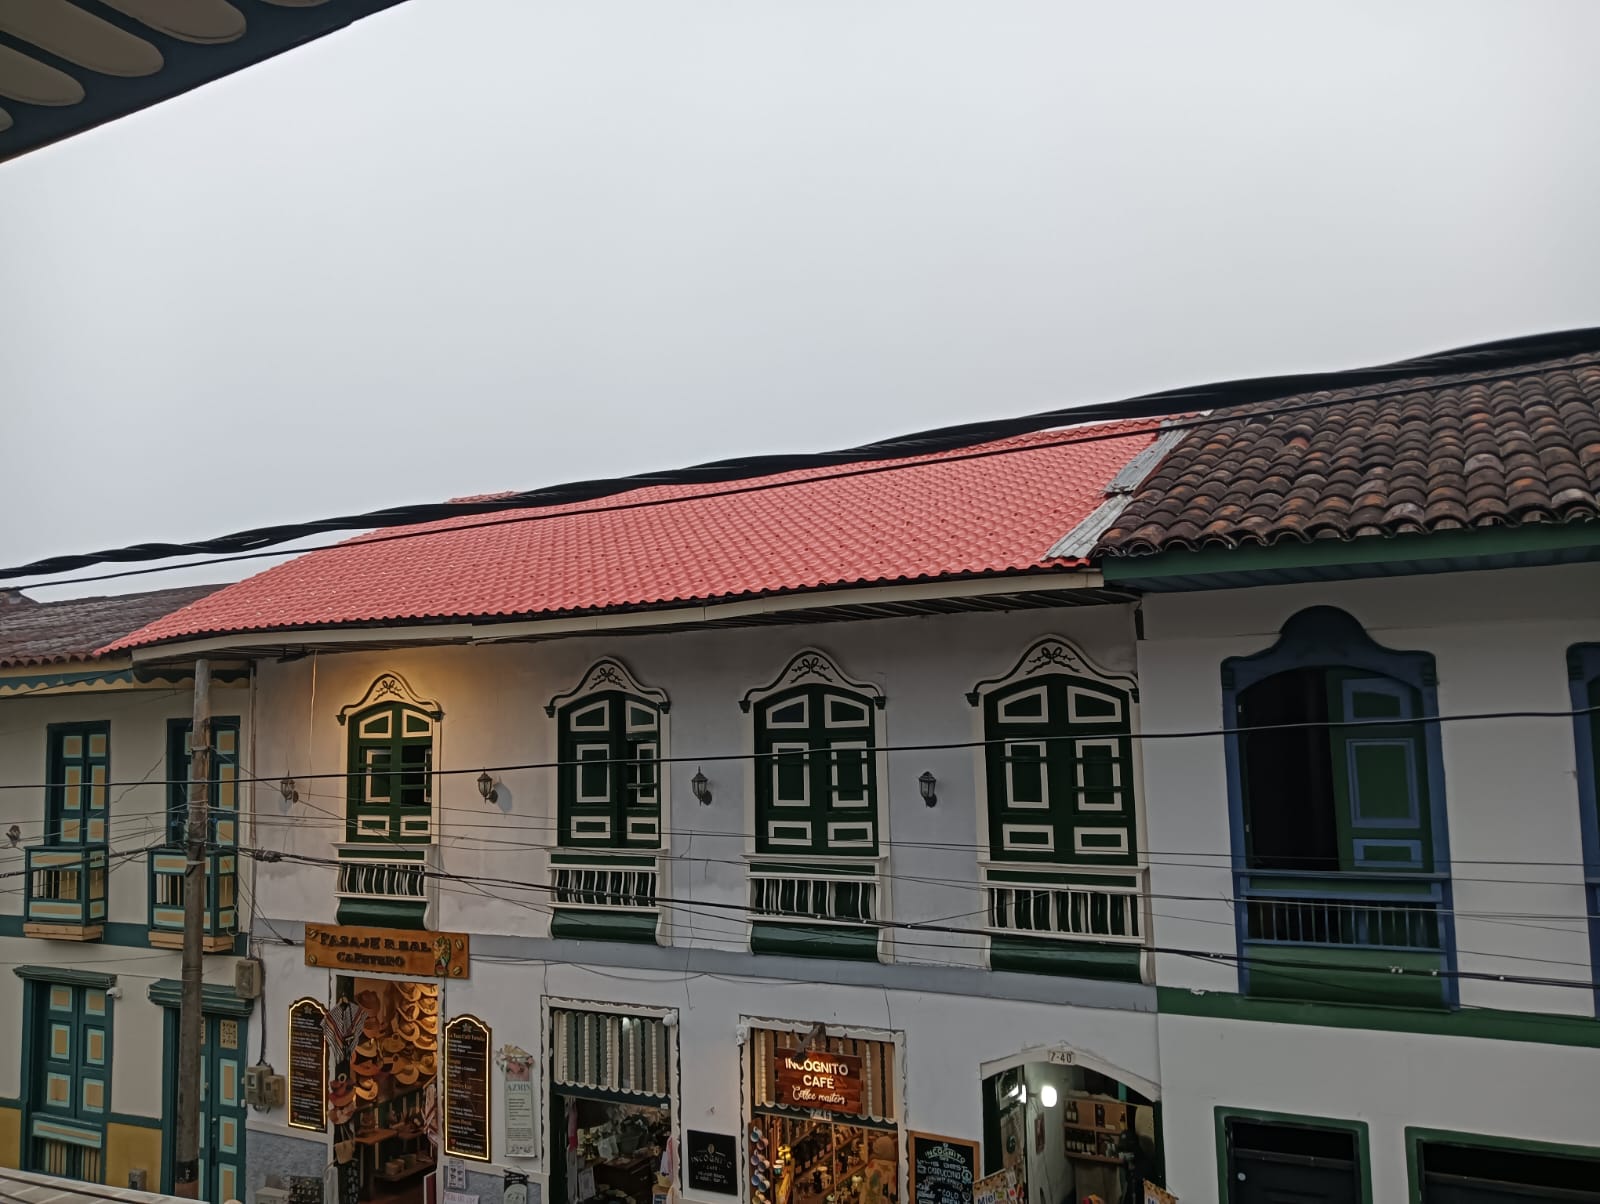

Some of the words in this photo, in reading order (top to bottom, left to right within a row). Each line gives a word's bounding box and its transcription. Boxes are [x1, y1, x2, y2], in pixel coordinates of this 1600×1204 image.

[320, 932, 381, 950] PASAJE
[385, 939, 432, 952] REAL
[1051, 1051, 1072, 1064] 7-40
[803, 1074, 835, 1090] CAFÉ
[792, 1085, 816, 1101] Coffee
